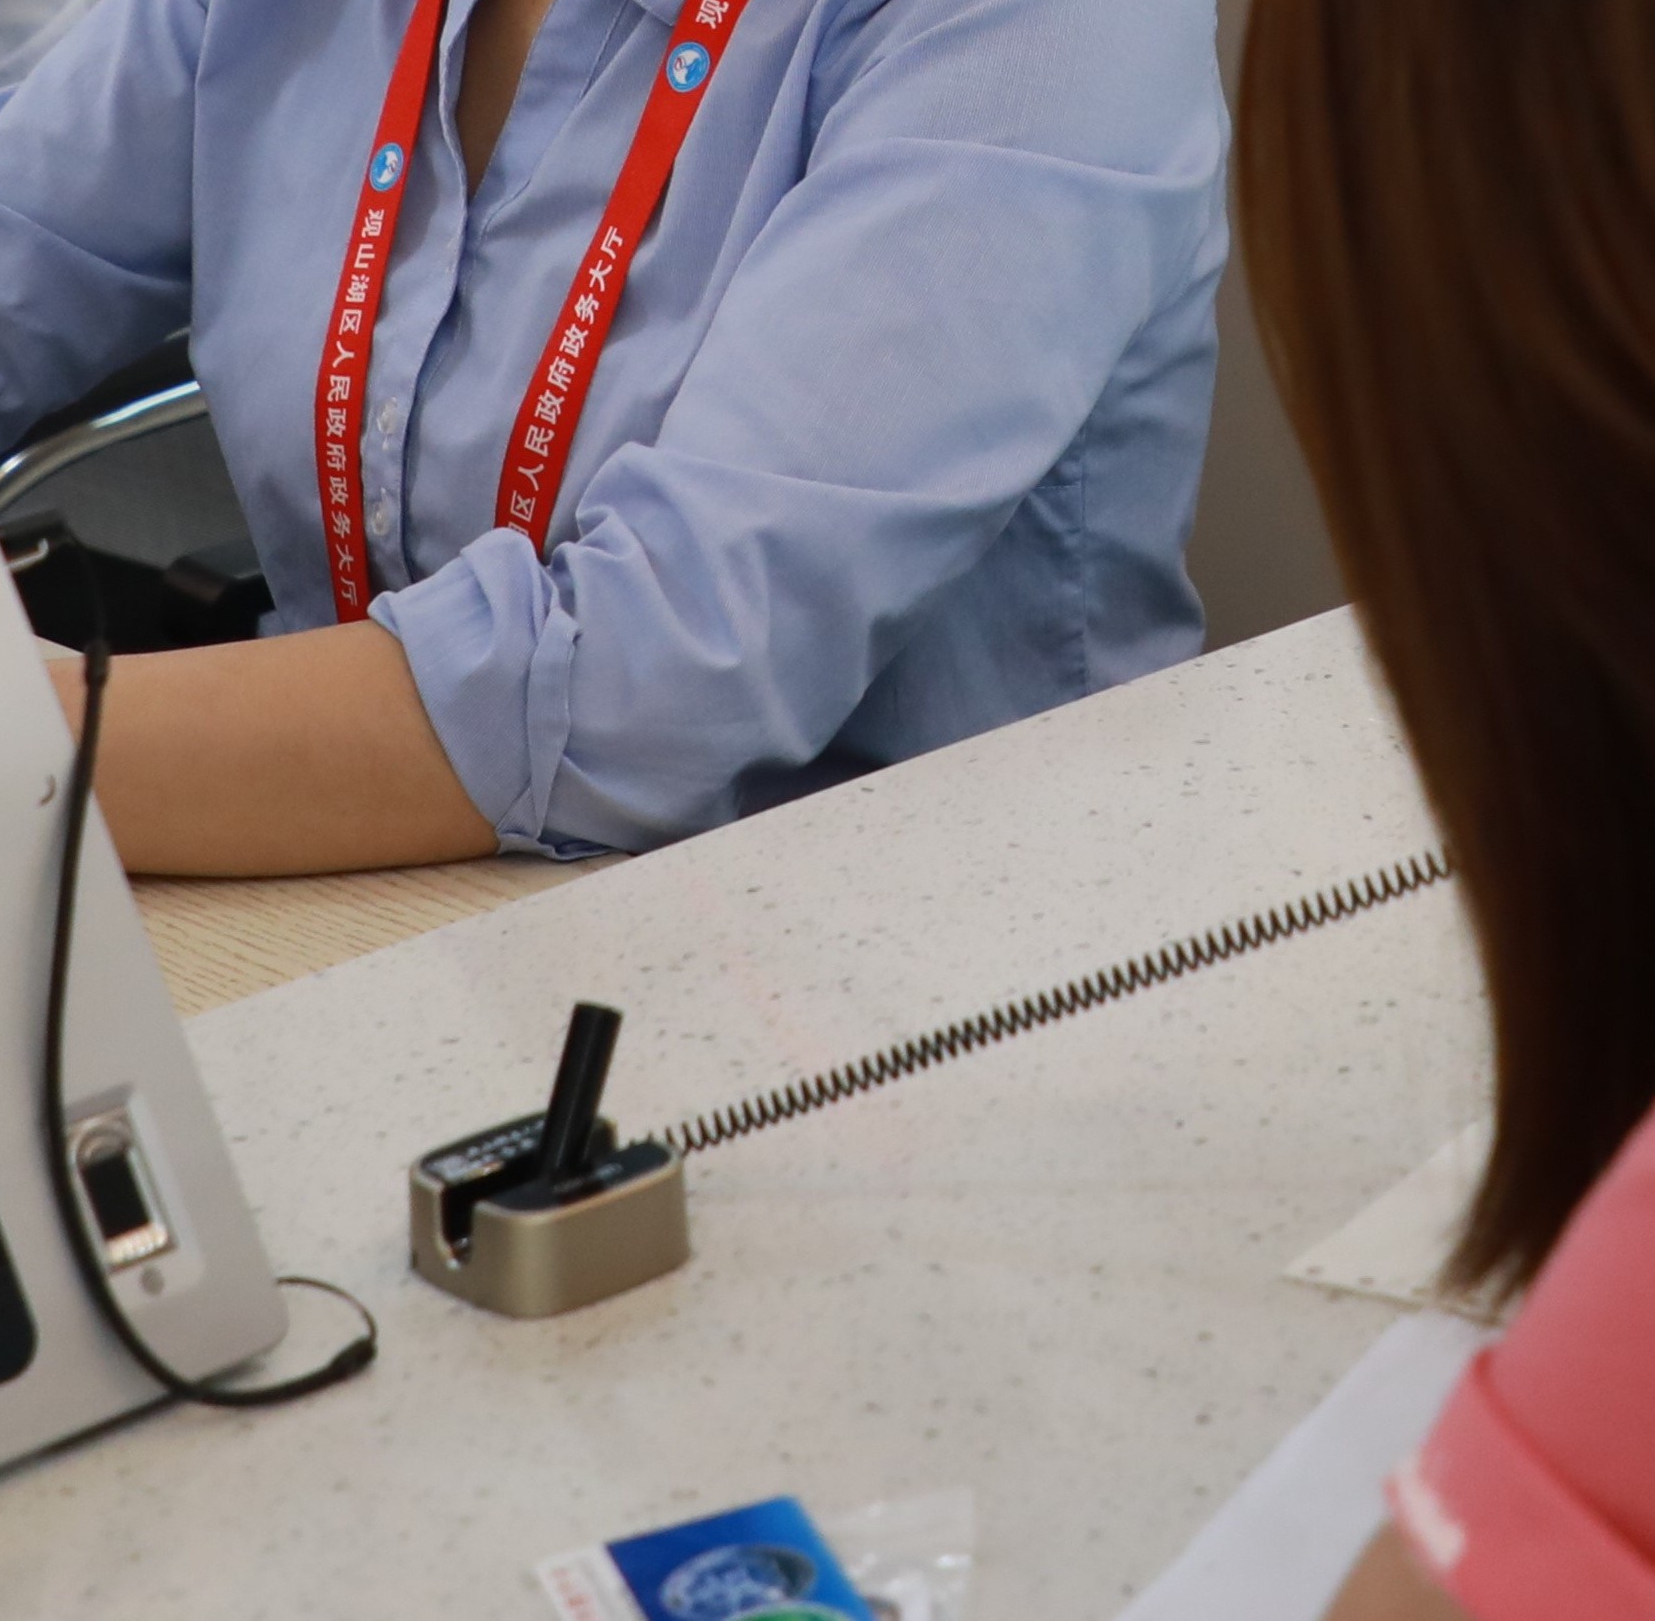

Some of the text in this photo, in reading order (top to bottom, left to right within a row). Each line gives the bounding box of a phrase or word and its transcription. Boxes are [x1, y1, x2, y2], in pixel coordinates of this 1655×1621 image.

[327, 208, 385, 608] 观山湖区人民政府政务大厅
